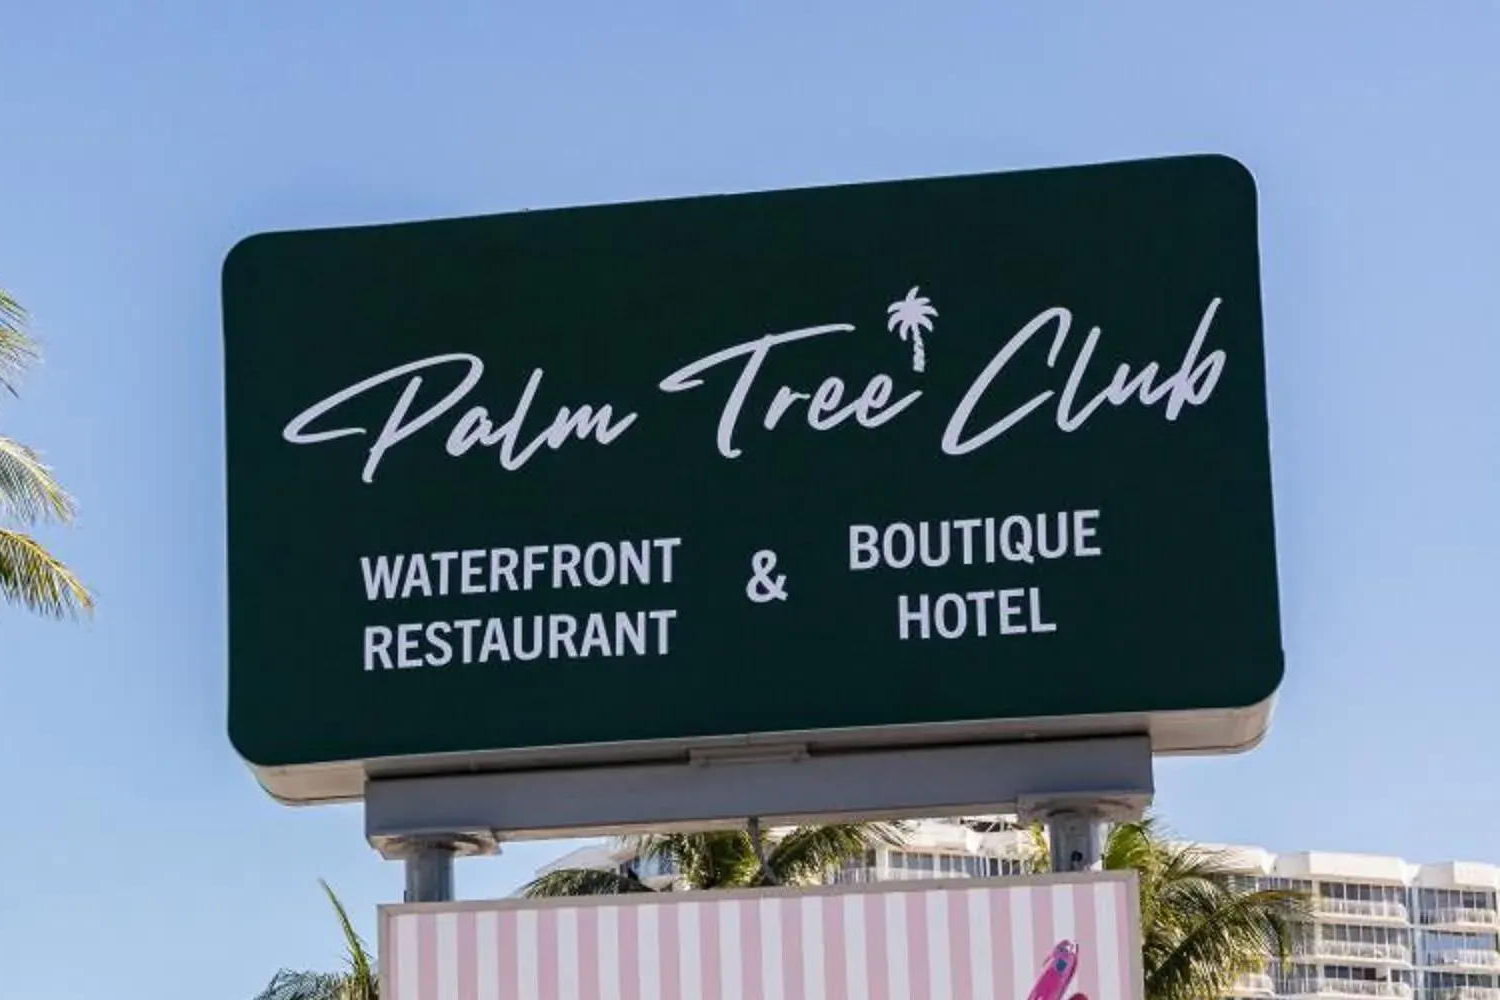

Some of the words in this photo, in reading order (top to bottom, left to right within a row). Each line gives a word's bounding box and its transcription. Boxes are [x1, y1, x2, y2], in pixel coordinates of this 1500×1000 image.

[283, 353, 638, 483] Palm
[659, 323, 923, 459] Tree
[942, 297, 1227, 455] Club
[360, 537, 682, 601] WATERFRONT
[849, 509, 1102, 570] BOUTIQUE
[745, 549, 789, 603] &
[364, 609, 677, 671] RESTAURANT
[898, 587, 1057, 640] HOTEL
